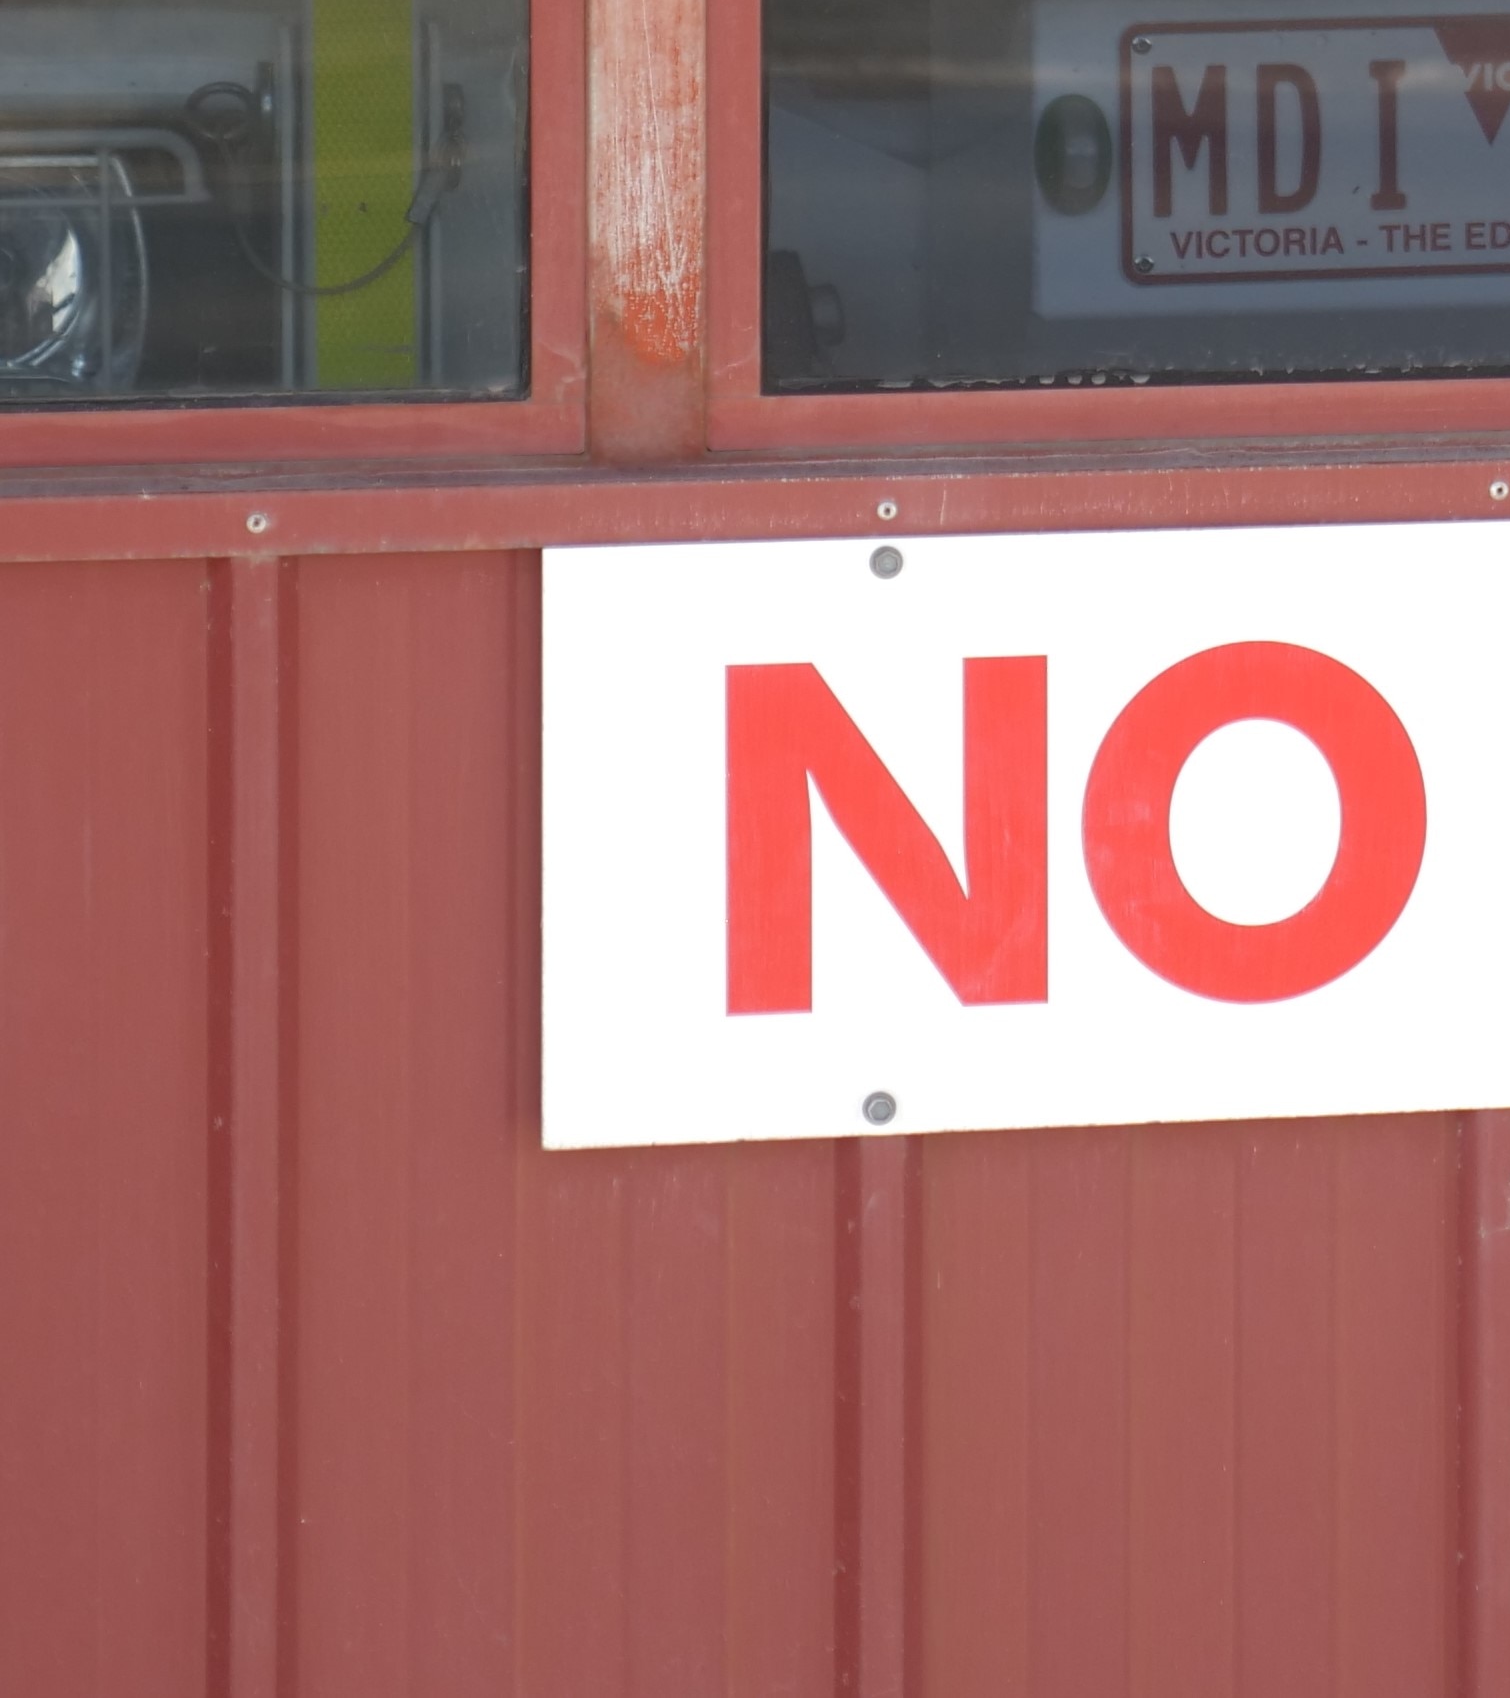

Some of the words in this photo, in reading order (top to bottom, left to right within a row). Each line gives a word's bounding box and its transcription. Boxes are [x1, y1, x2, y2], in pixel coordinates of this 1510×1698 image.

[1170, 226, 1344, 260] VICTORIA
[1379, 222, 1451, 253] THE
[725, 639, 1428, 1016] NO
